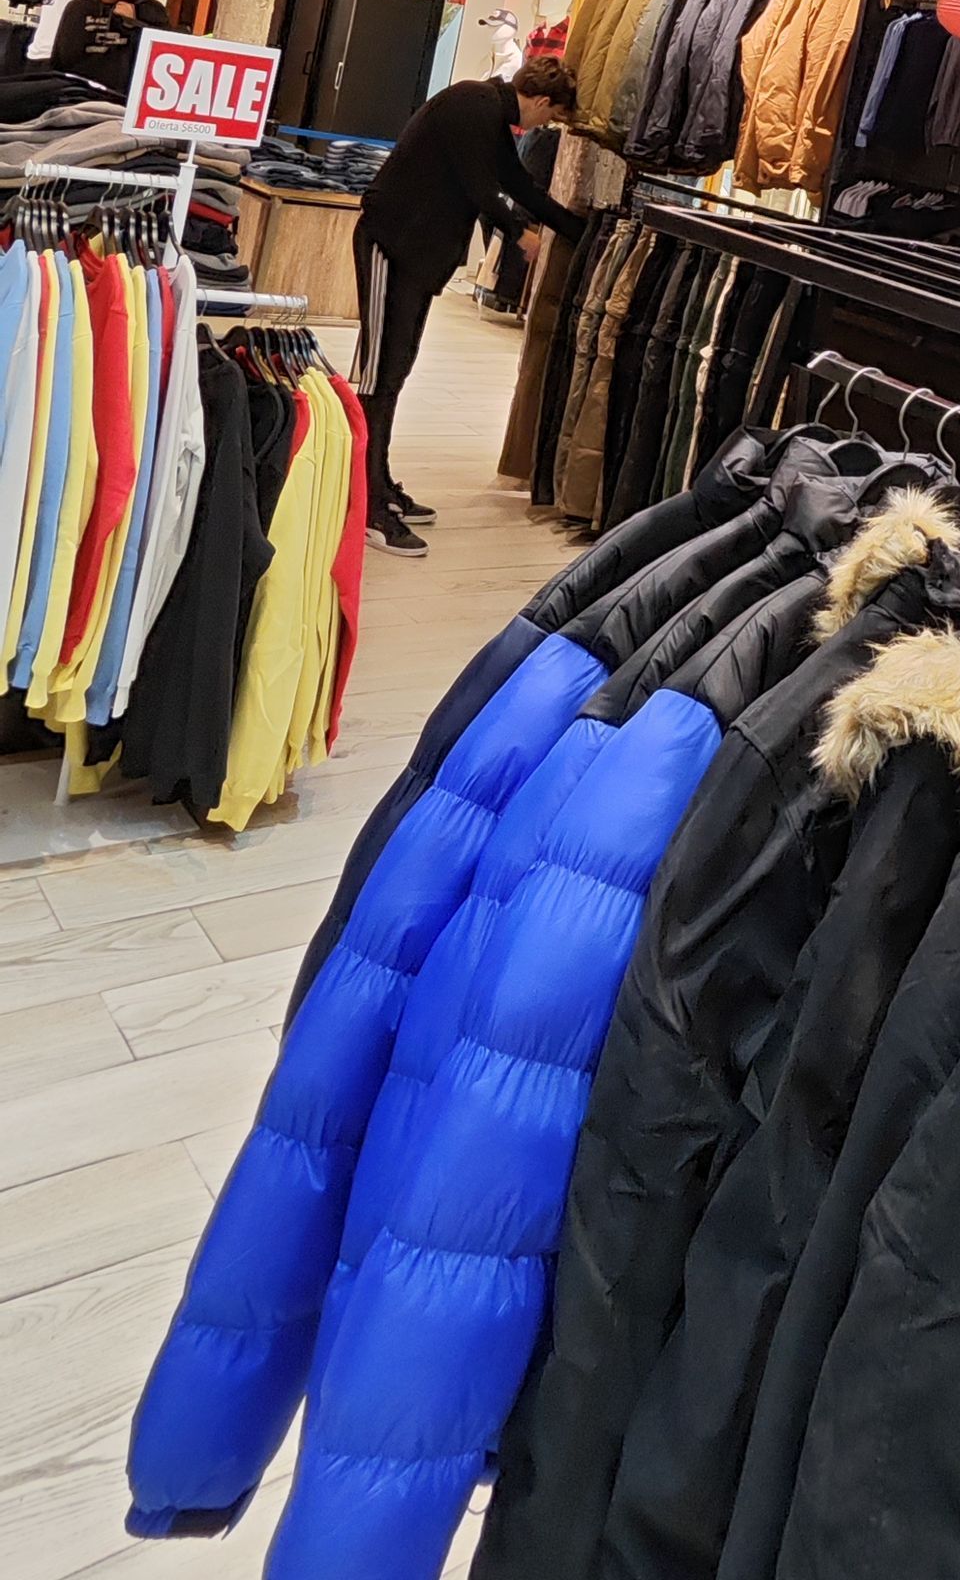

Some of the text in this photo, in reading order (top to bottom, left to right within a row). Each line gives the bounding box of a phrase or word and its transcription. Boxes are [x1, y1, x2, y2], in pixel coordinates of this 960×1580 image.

[146, 53, 268, 123] SALE
[148, 119, 211, 135] Oferta $6500
